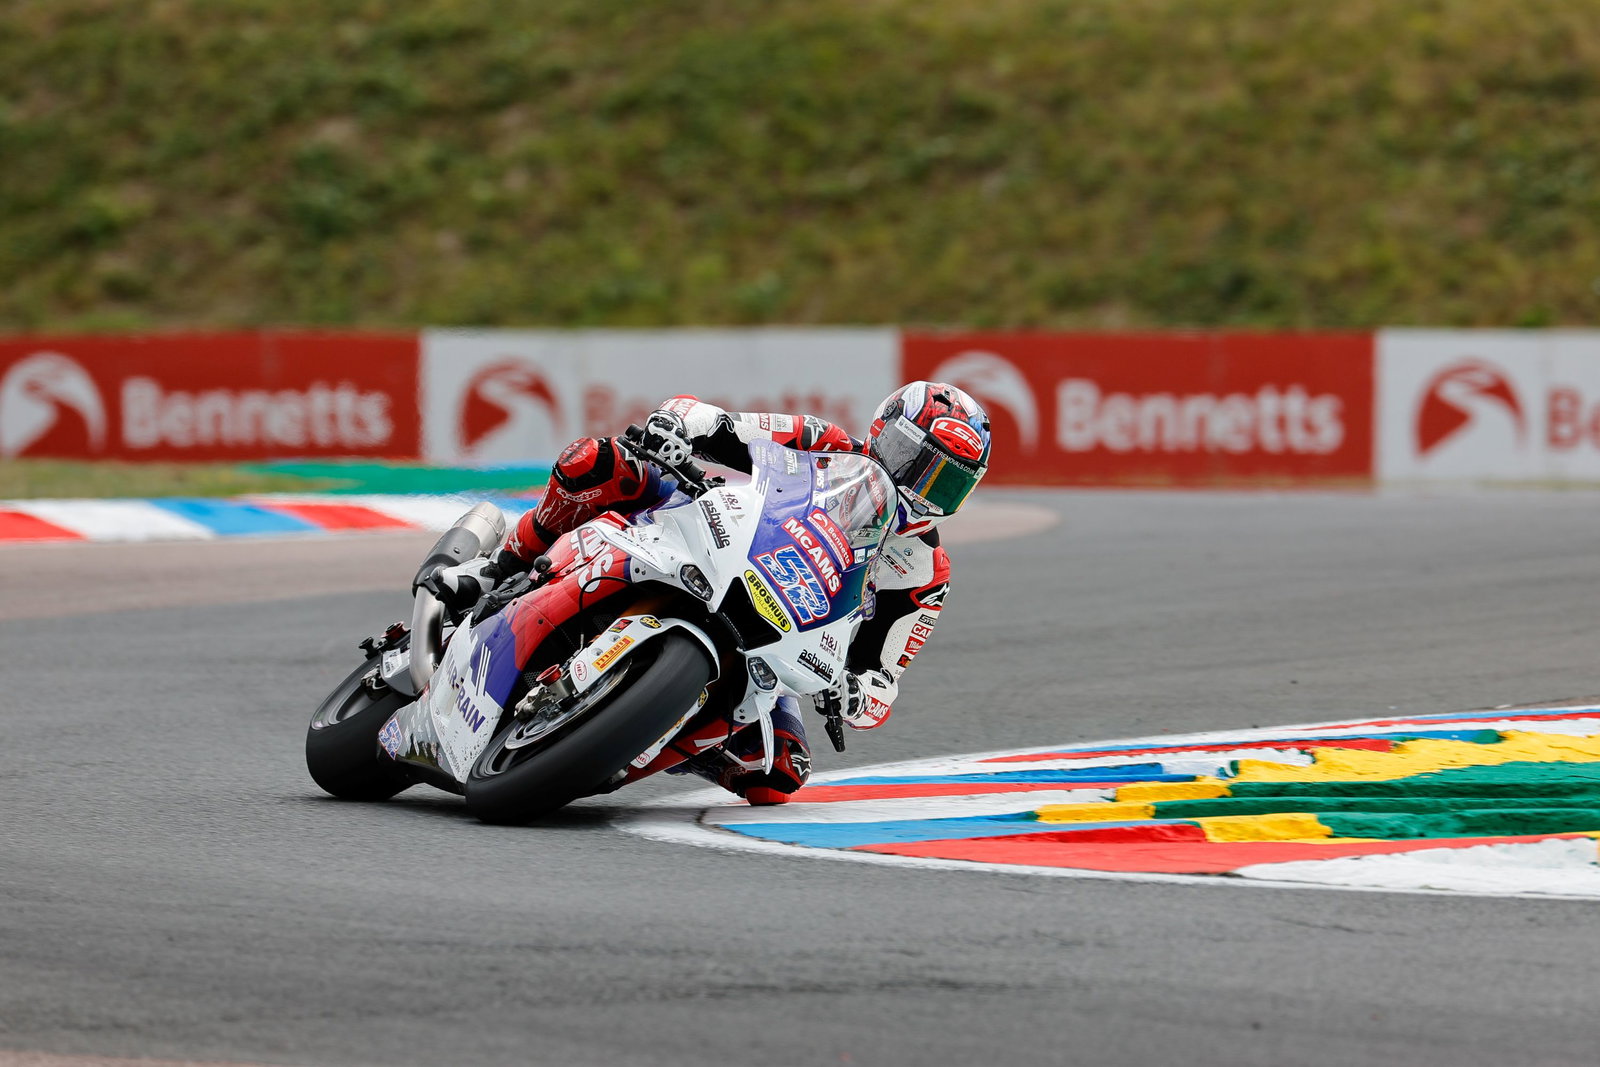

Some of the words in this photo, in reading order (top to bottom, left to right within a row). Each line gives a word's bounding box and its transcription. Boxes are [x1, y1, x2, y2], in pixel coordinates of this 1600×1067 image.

[120, 376, 393, 448] Bennetts
[1056, 377, 1346, 453] Bennetts
[936, 421, 982, 453] LS2
[706, 500, 731, 547] ashvale
[827, 527, 851, 565] Bennetts
[784, 520, 841, 593] McAMS
[748, 574, 788, 630] BROSHUIS
[752, 591, 775, 620] HOLLAND
[756, 545, 830, 625] 52
[595, 637, 631, 669] PIRELLI
[800, 649, 834, 675] ashvale
